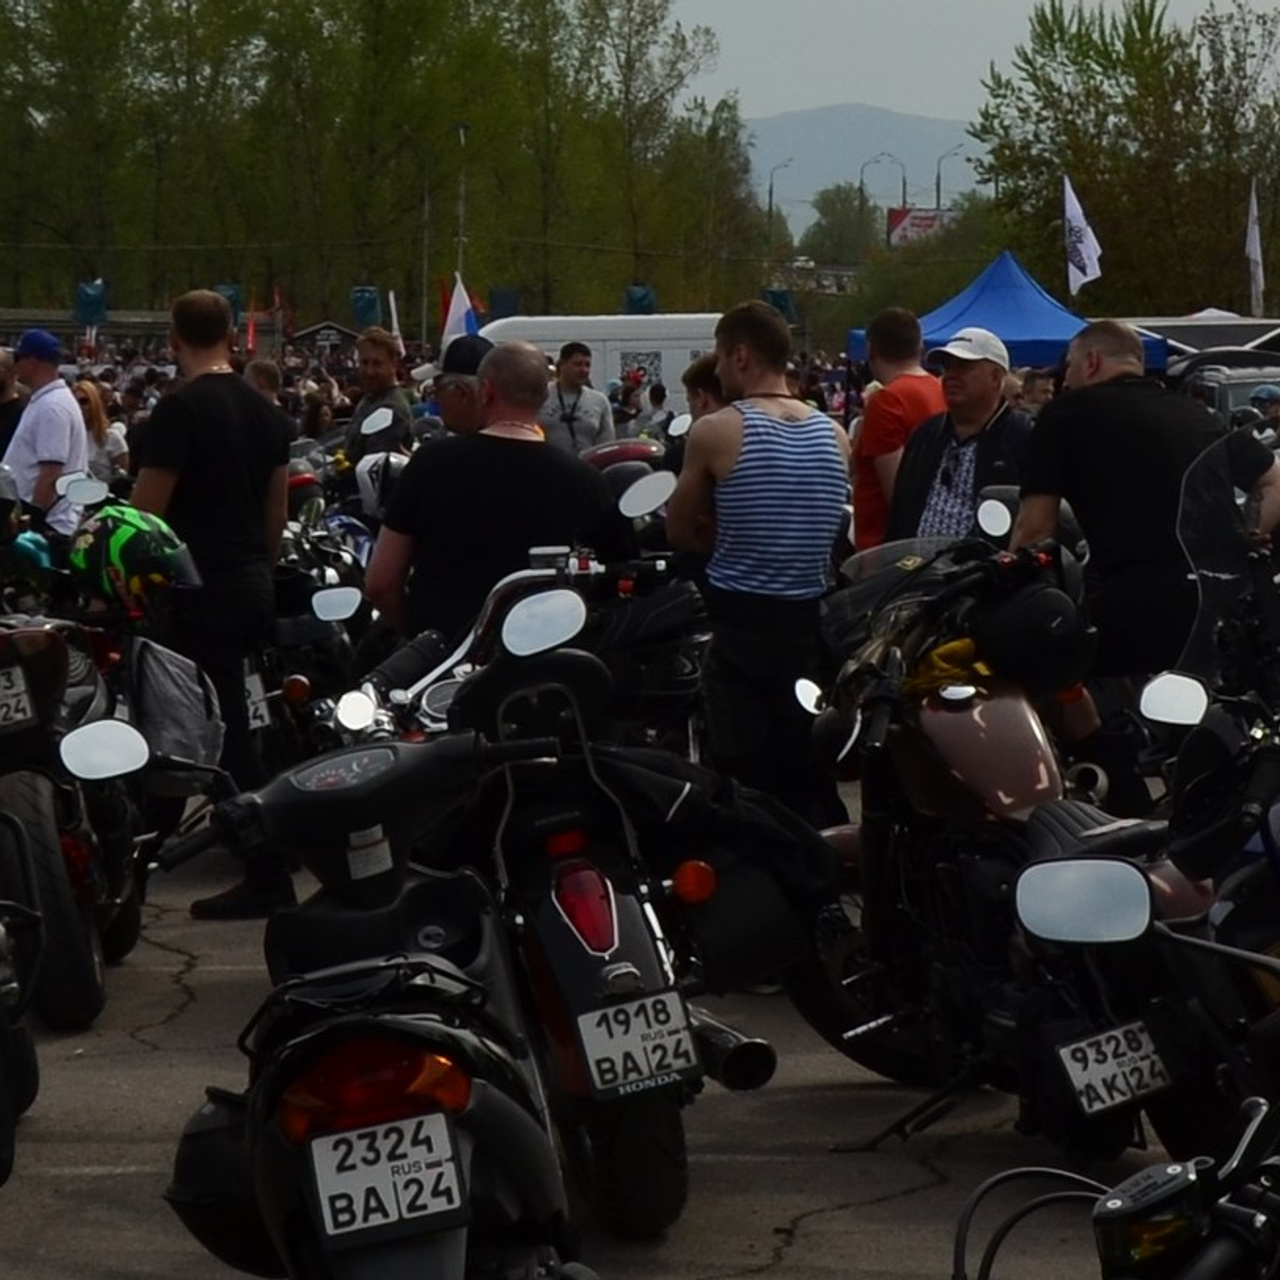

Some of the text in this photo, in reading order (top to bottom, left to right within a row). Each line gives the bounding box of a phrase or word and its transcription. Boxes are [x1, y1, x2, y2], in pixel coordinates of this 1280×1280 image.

[0, 699, 27, 721] 24
[595, 999, 671, 1039] 1918
[641, 1030, 665, 1041] RUS
[596, 1038, 691, 1085] BA 24
[1070, 1029, 1142, 1072] 9328
[618, 1072, 682, 1095] HONDA
[1084, 1061, 1168, 1109] AK 24
[332, 1120, 434, 1174] 2324
[391, 1160, 422, 1177] RUS
[328, 1172, 454, 1230] BA 24
